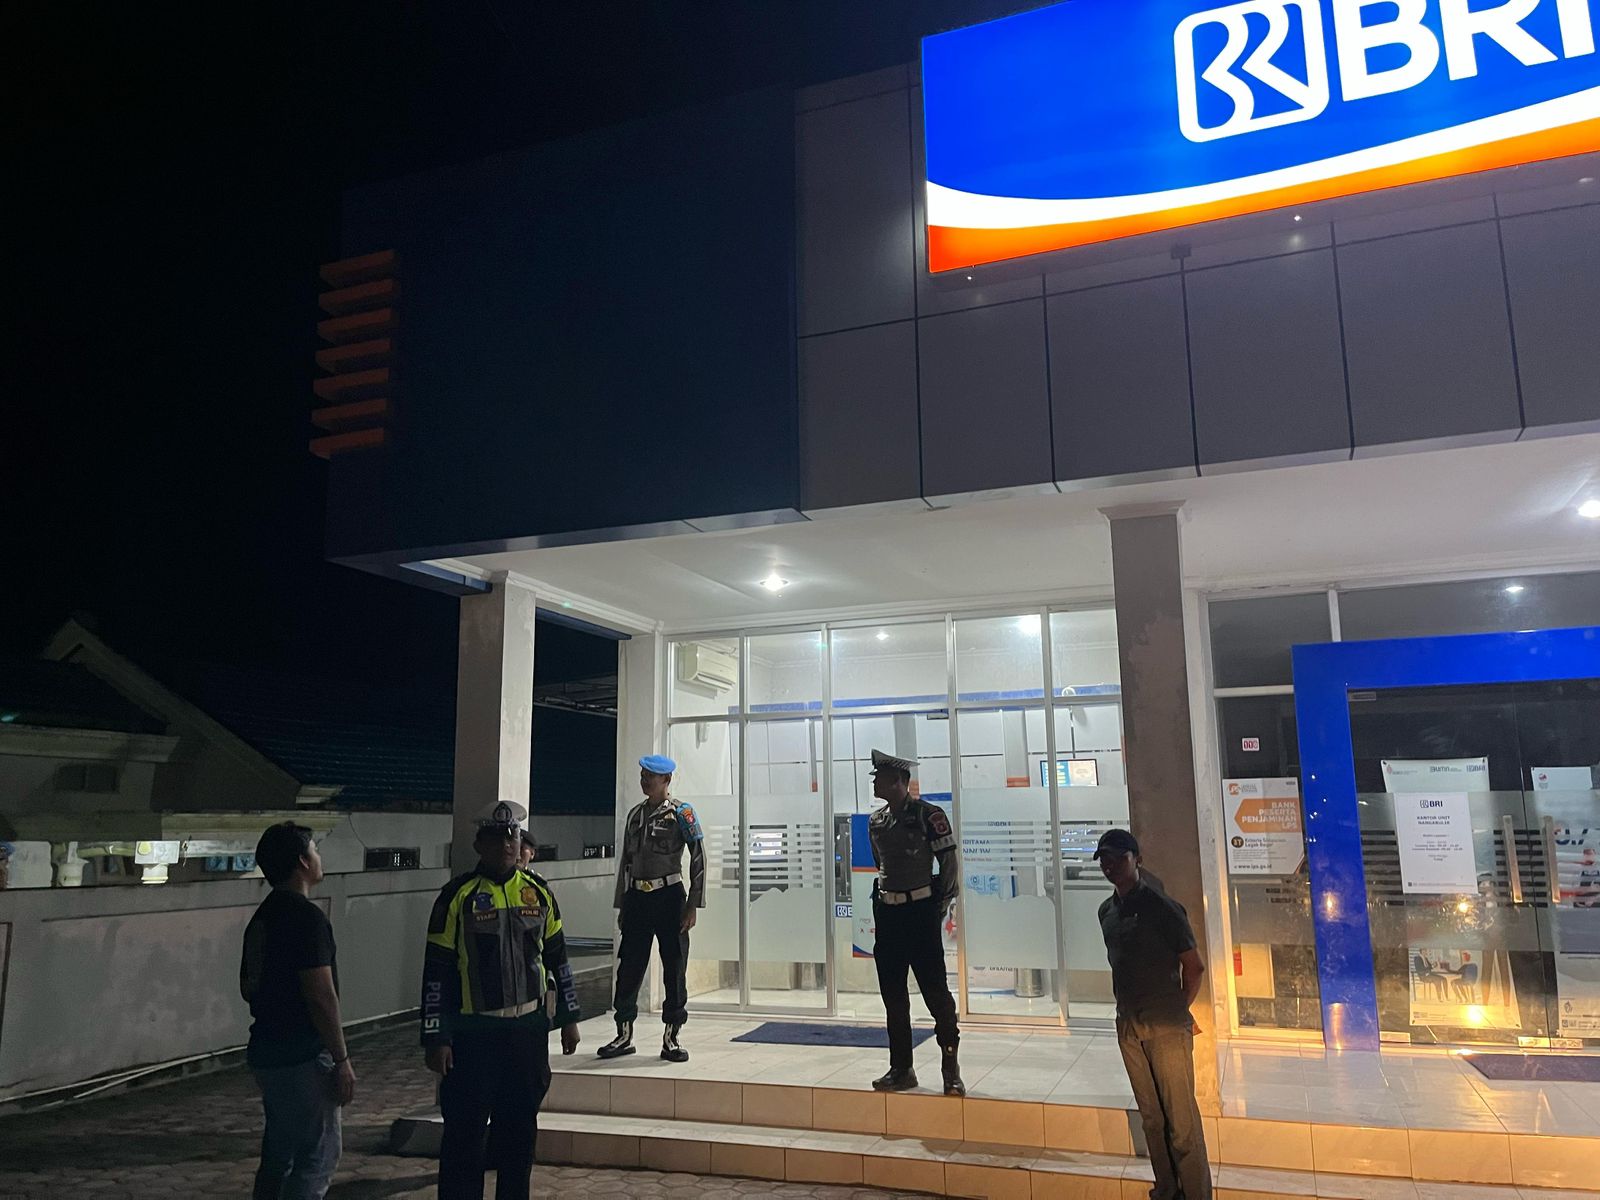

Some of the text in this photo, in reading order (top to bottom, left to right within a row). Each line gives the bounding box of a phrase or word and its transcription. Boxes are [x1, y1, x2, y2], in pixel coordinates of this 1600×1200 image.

[1332, 0, 1596, 102] BRI
[1241, 815, 1297, 823] PENJAMINAN
[1258, 808, 1297, 816] PESERTA
[424, 982, 441, 1034] POLISI
[558, 963, 581, 1012] POLISI
